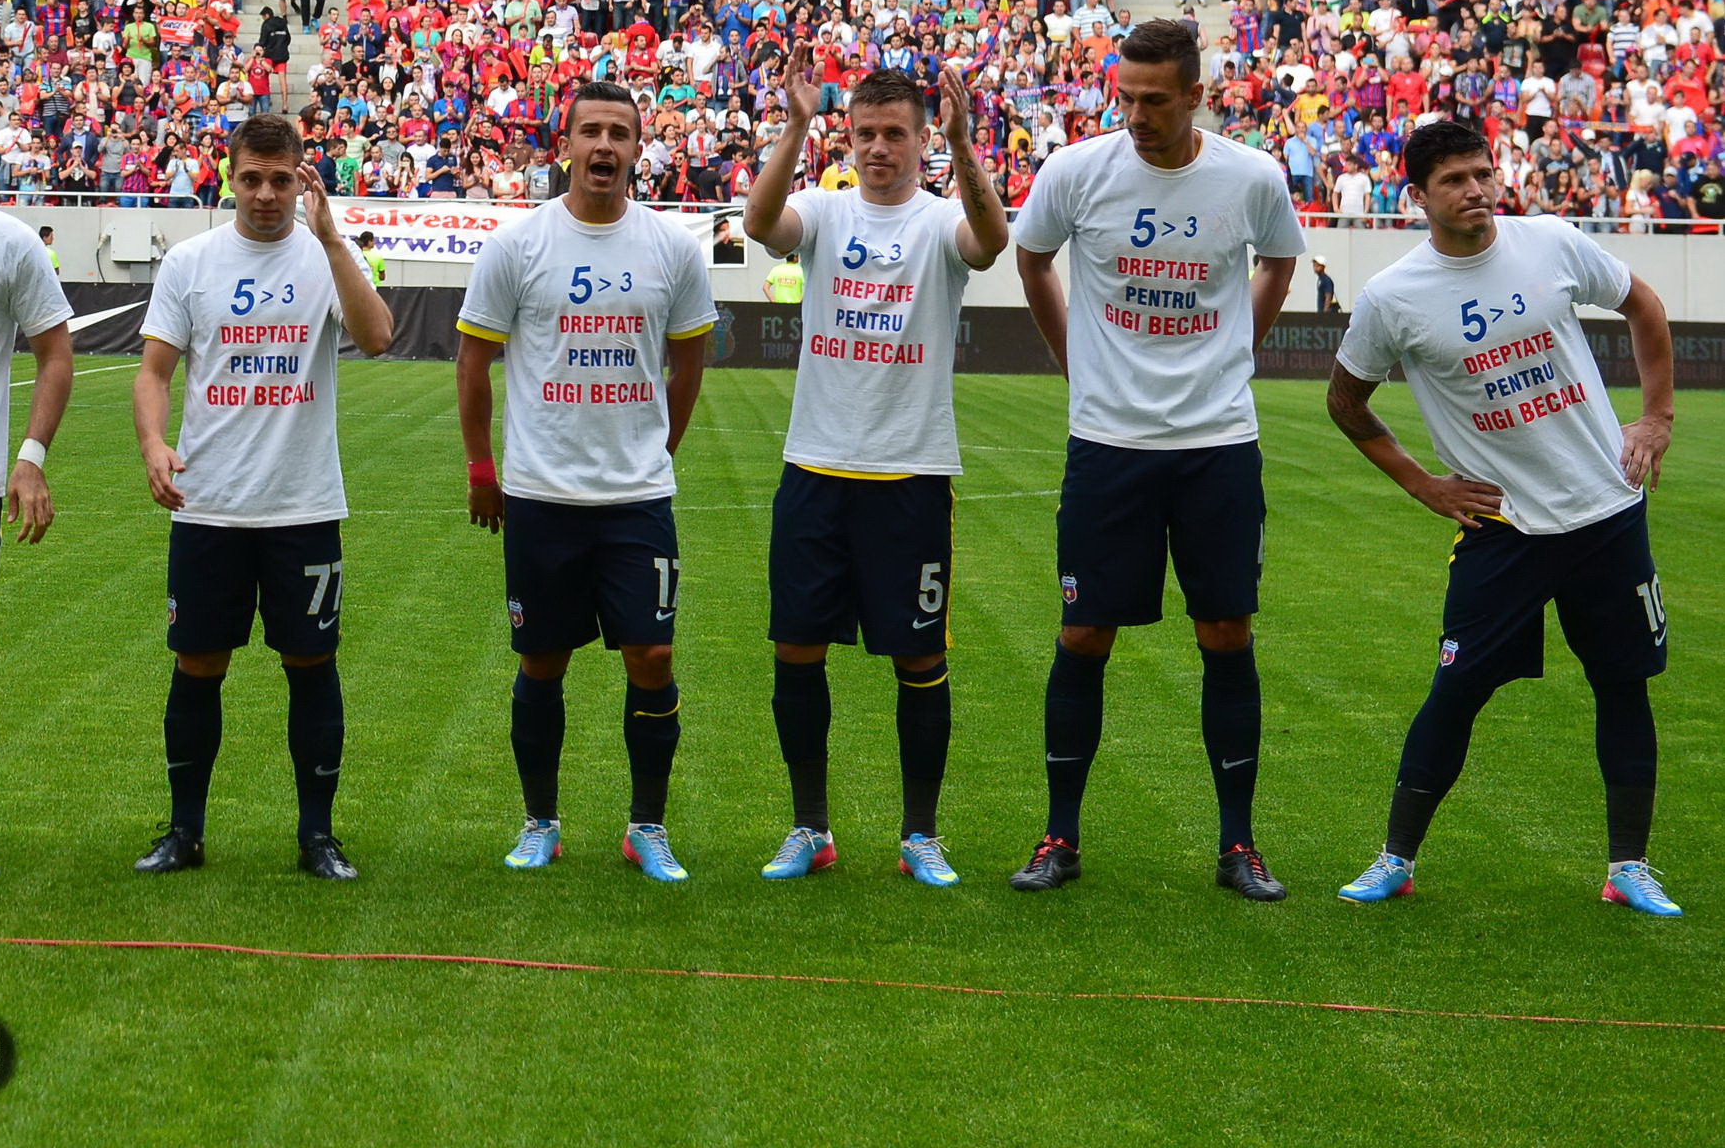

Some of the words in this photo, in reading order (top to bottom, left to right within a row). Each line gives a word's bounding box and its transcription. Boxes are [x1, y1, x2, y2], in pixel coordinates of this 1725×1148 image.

[1130, 209, 1156, 247] 5
[1184, 217, 1198, 238] 3
[842, 236, 867, 270] 5
[890, 244, 901, 261] 3
[1118, 257, 1208, 281] DREPTATE
[231, 279, 255, 316] 5
[282, 284, 294, 304] 3
[568, 266, 592, 305] 5
[620, 272, 632, 292] 3
[832, 277, 915, 303] DREPTATE
[1125, 286, 1196, 310] PENTRU
[560, 316, 643, 333] DREPTATE
[835, 308, 903, 333] PENTRU
[1105, 303, 1141, 332] GIGI
[1148, 310, 1219, 335] BECALI
[1461, 300, 1487, 343] 5
[1512, 293, 1526, 315] 3
[221, 325, 307, 344] DREPTATE
[810, 334, 846, 359] GIGI
[853, 341, 924, 364] BECALI
[232, 356, 299, 374] PENTRU
[569, 350, 633, 367] PENTRU
[1462, 331, 1555, 375] DREPTATE
[207, 385, 247, 406] GIGI
[254, 385, 315, 406] BECALI
[543, 382, 583, 403] GIGI
[591, 384, 653, 404] BECALI
[1484, 361, 1555, 401] PENTRU
[1472, 409, 1516, 432] GIGI
[1518, 382, 1587, 424] BECALI
[918, 562, 943, 613] 5
